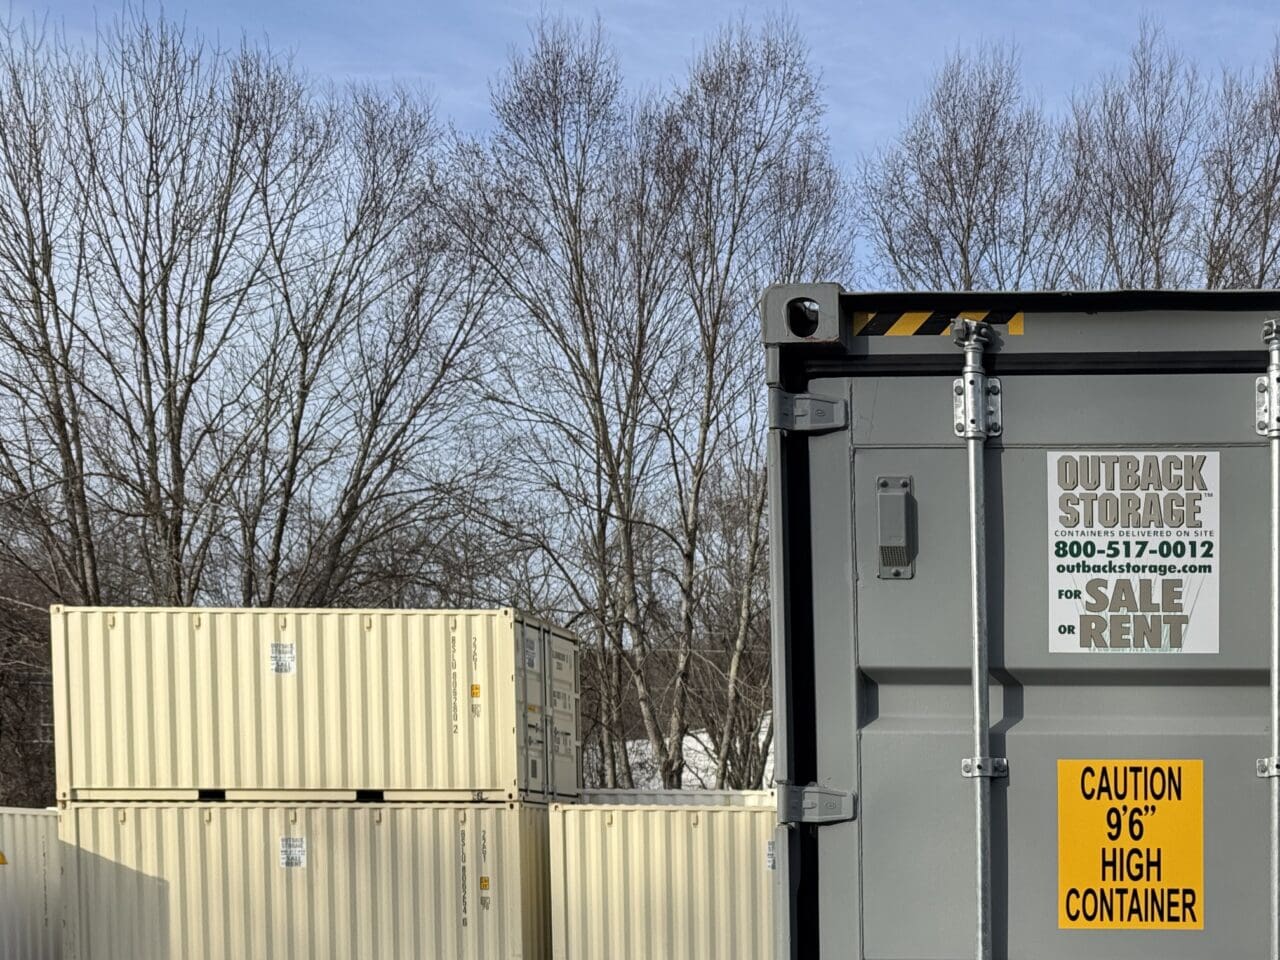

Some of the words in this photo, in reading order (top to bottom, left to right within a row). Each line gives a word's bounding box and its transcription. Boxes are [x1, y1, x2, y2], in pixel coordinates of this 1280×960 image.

[1057, 455, 1207, 490] OUTBACK
[1058, 492, 1202, 528] STORAGE
[1054, 541, 1214, 558] 800-517-0012
[1056, 561, 1212, 576] outbackstorage.com
[1058, 590, 1082, 600] FOR
[1085, 578, 1183, 612] SALE
[1058, 624, 1075, 634] OR
[1080, 615, 1189, 648] RENT
[1080, 766, 1182, 800] CAUTION
[1101, 848, 1162, 882] HIGH
[1066, 888, 1197, 922] CONTAINER
